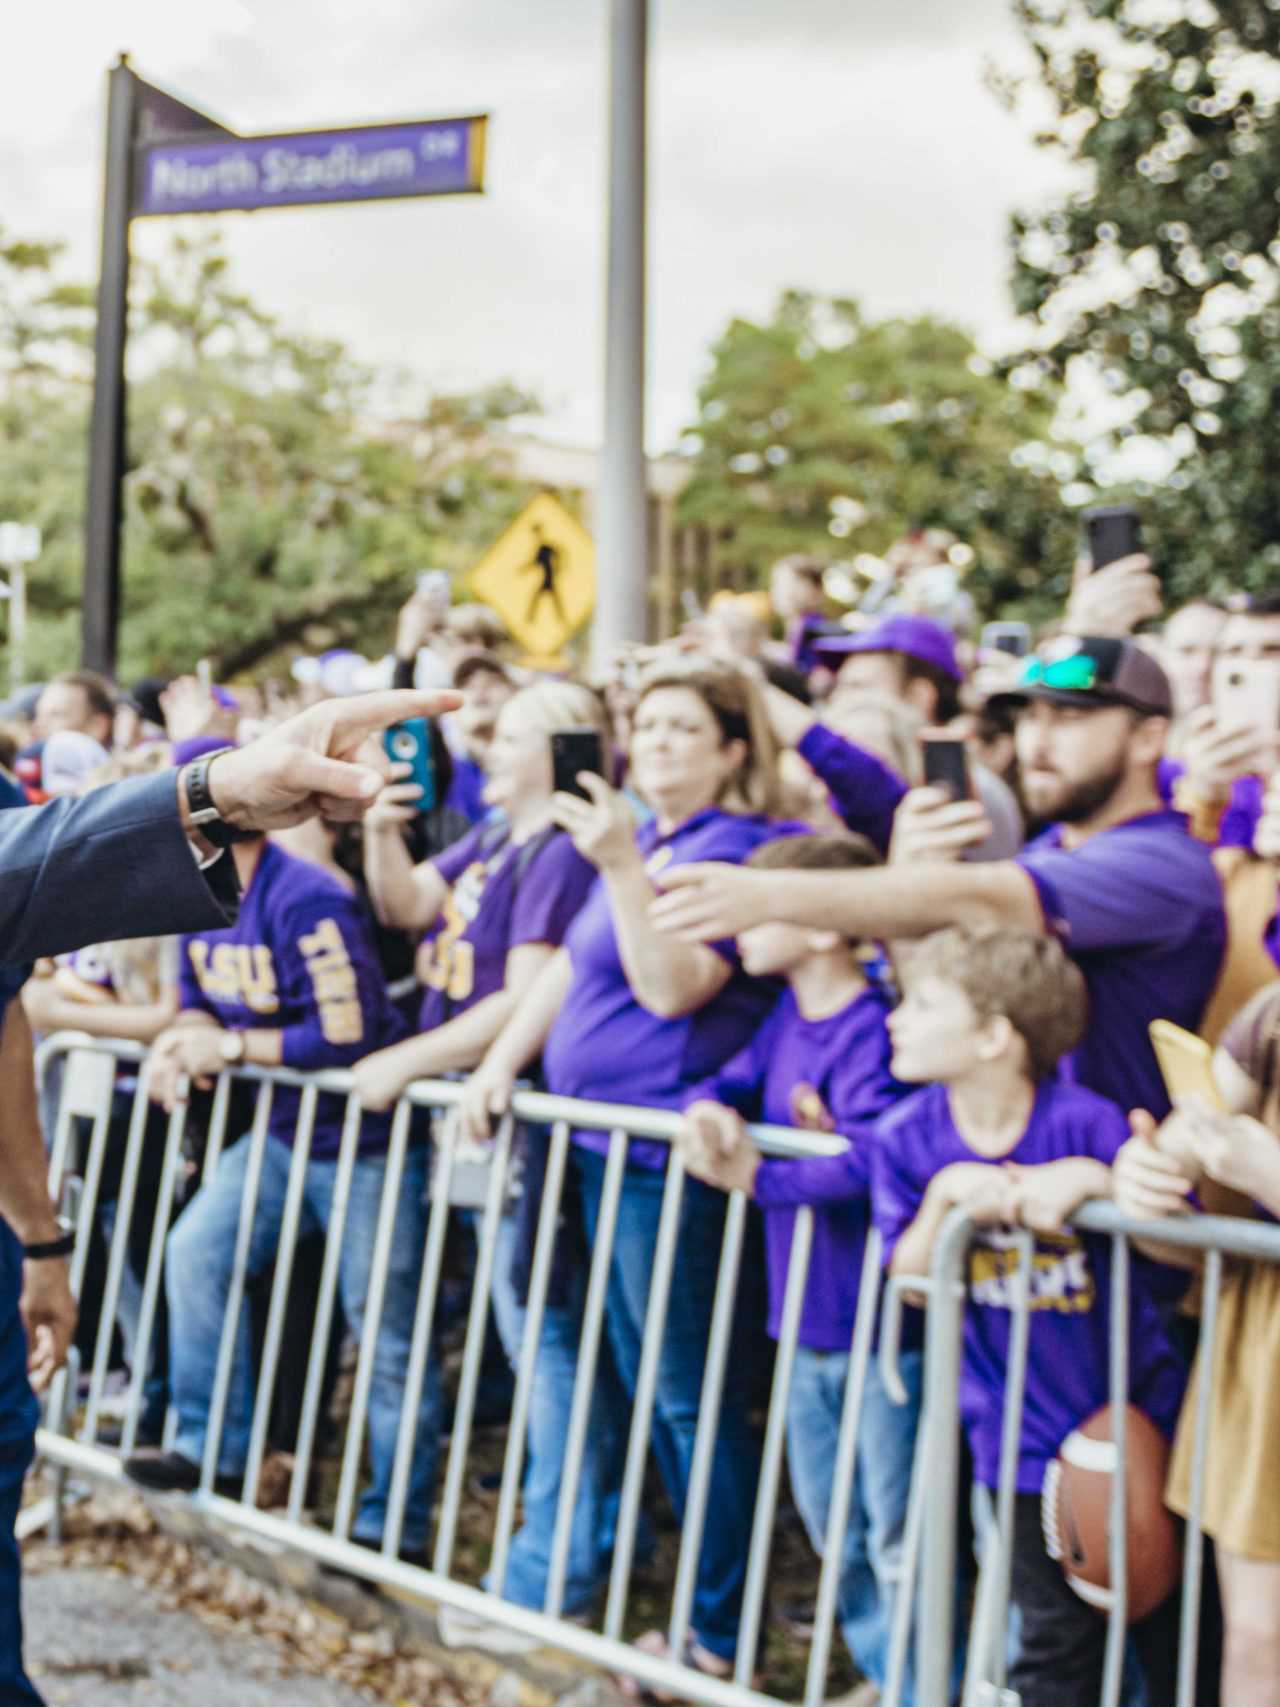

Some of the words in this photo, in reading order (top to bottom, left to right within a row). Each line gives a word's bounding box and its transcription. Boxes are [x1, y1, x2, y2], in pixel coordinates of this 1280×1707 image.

[151, 151, 258, 198] North
[260, 143, 414, 194] Stadium
[188, 938, 278, 1004] LSU
